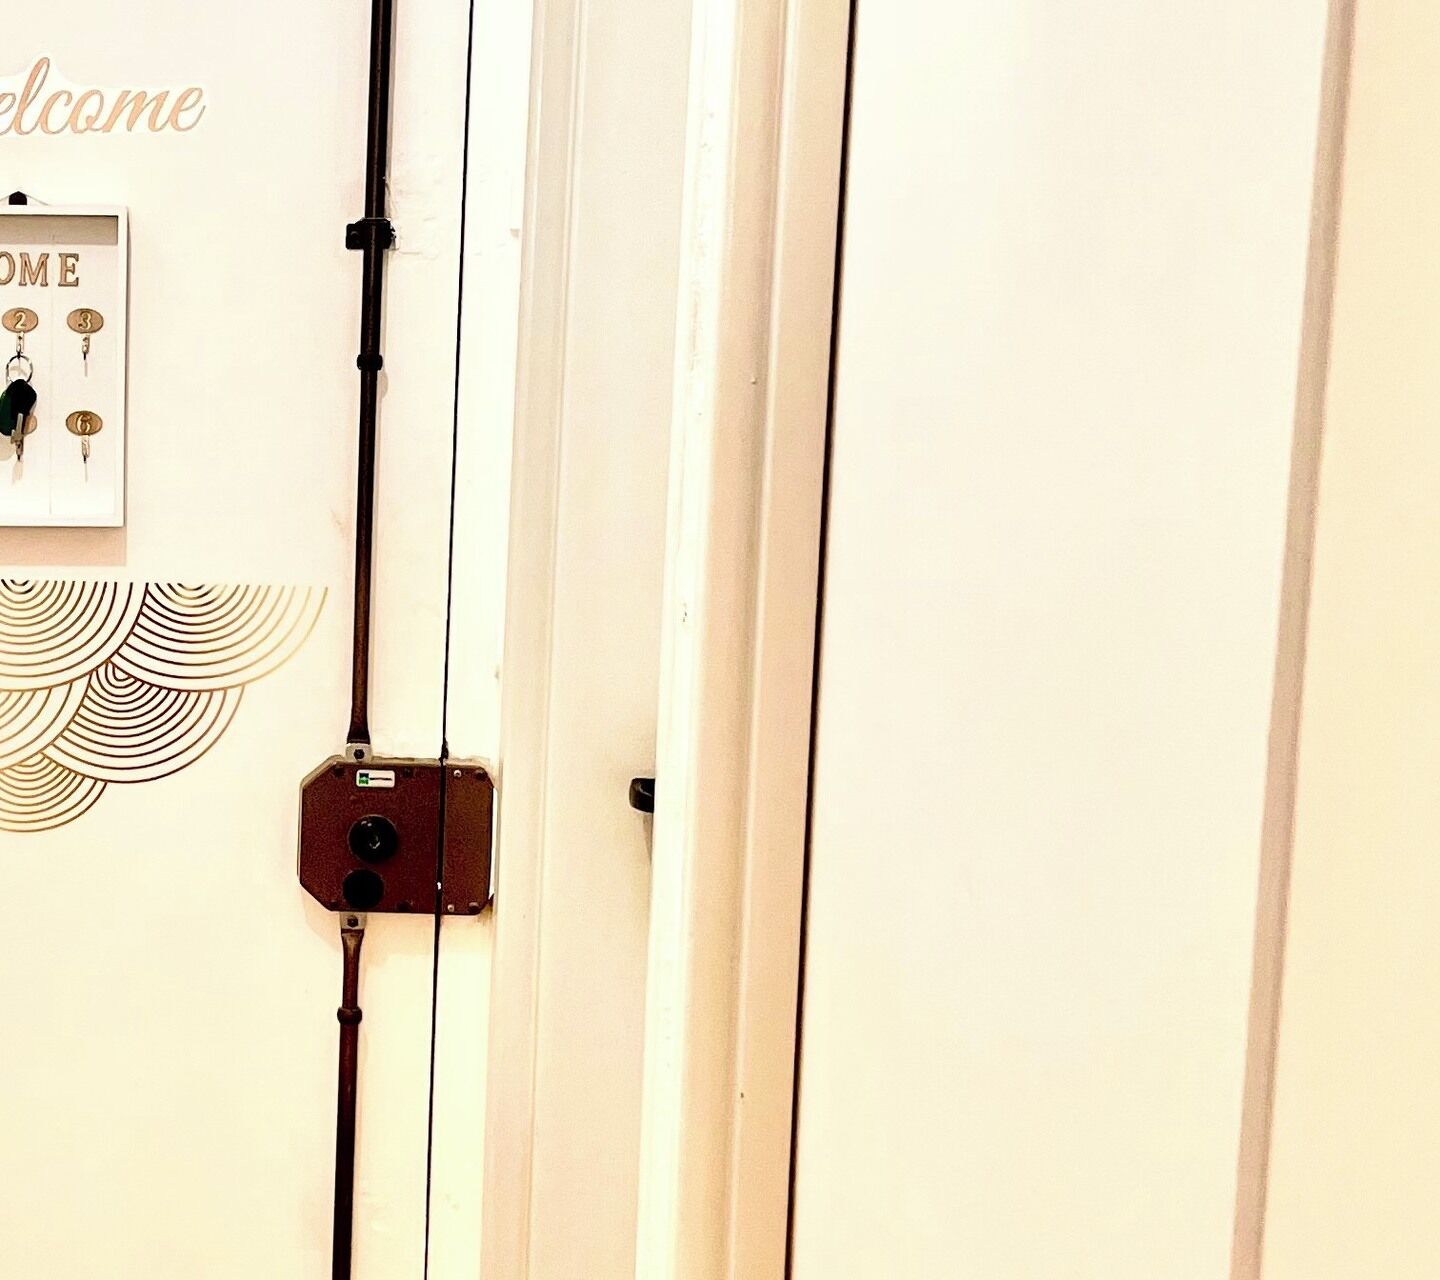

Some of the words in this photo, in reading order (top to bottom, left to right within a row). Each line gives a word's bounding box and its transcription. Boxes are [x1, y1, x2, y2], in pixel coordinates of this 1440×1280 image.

[13, 310, 27, 330] 2
[77, 310, 92, 330] 3
[75, 413, 92, 434] 6
